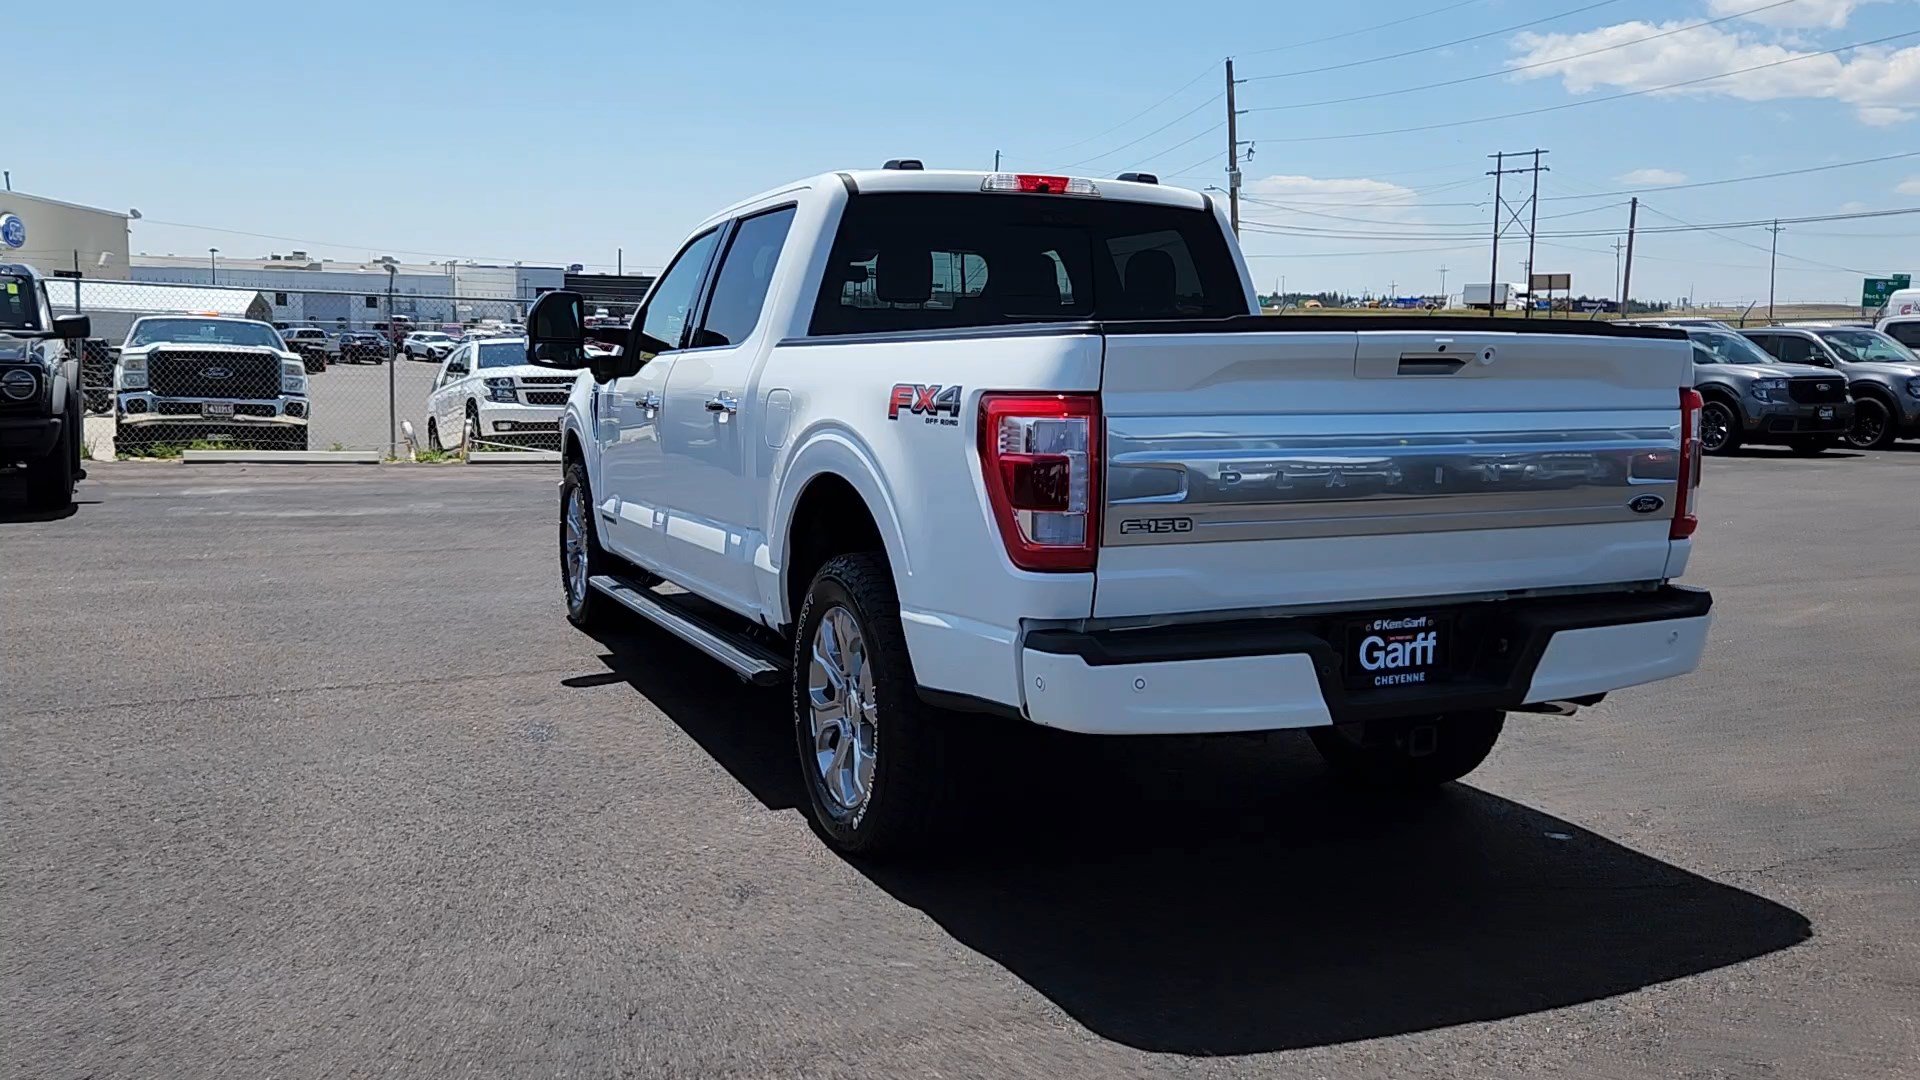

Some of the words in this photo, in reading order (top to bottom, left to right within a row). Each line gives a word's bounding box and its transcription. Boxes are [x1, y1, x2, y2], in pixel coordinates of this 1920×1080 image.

[888, 383, 963, 420] FX4
[940, 418, 959, 427] ROAD
[1120, 517, 1193, 534] F-150
[1382, 619, 1402, 630] Ken
[1402, 616, 1427, 628] Garff
[1359, 631, 1437, 671] Garff
[1374, 672, 1425, 685] CHEYENNE
